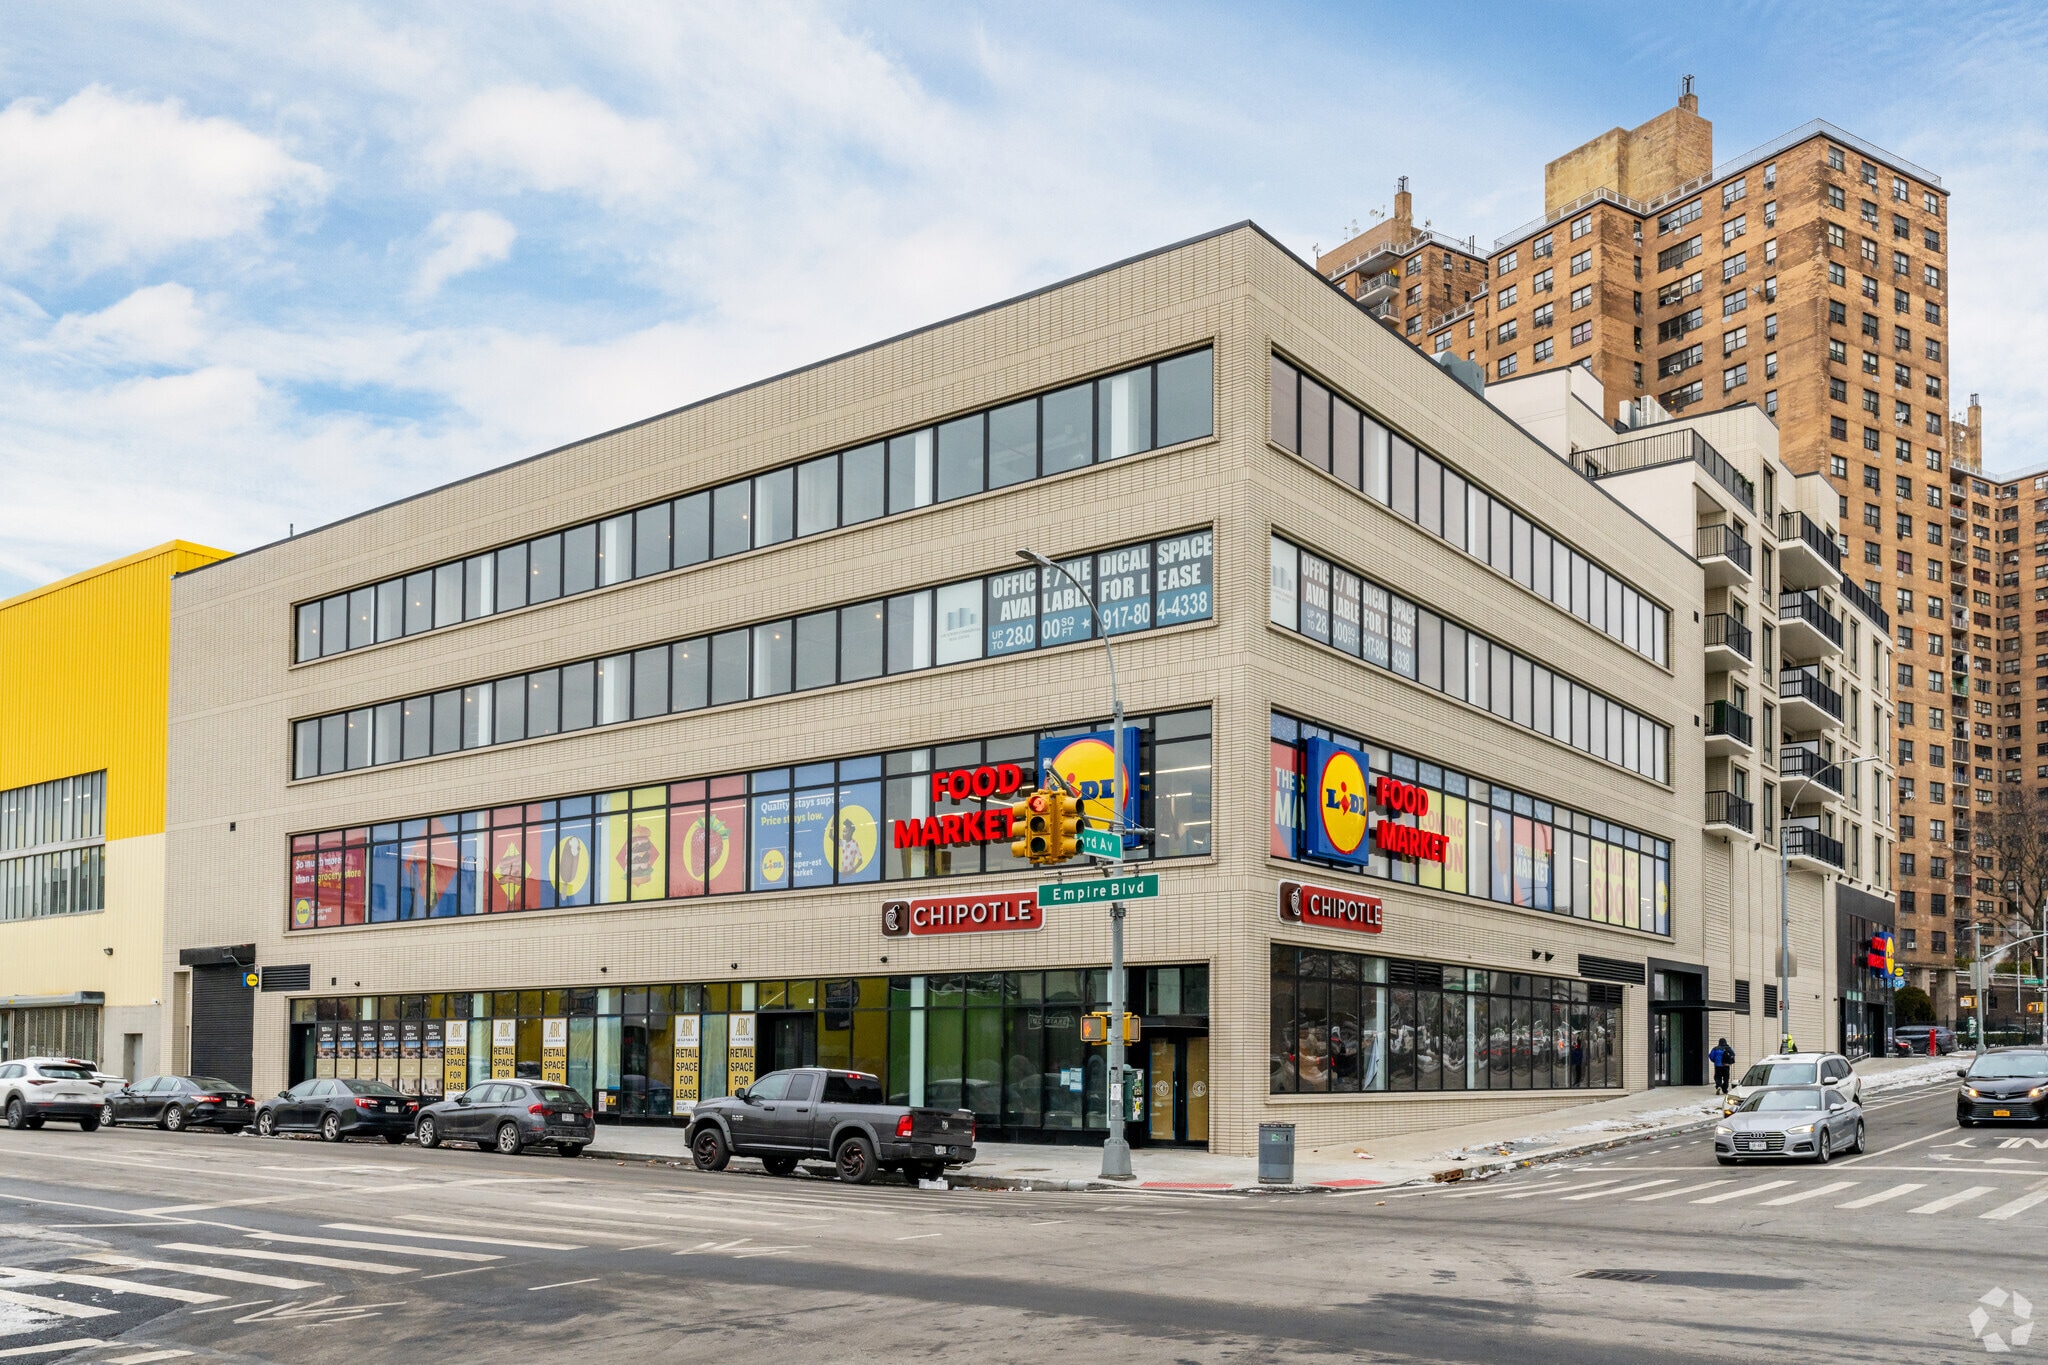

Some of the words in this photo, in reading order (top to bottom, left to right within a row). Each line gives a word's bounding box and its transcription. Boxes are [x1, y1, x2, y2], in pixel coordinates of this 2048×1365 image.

[993, 567, 1051, 599] OFFICE
[1066, 547, 1150, 584] MEDICAL
[1157, 533, 1212, 565] SPACE
[1000, 584, 1092, 622] AVAILABLE
[1101, 576, 1134, 602] FOR
[1141, 562, 1201, 595] LEASE
[1302, 554, 1338, 590] OFFICE
[1346, 576, 1389, 614] MEDICAL
[1391, 596, 1416, 627] SPACE
[1103, 590, 1208, 631] 917-804-4338
[1305, 581, 1360, 625] AVAILABLE
[1364, 608, 1382, 635] FOR
[1384, 617, 1412, 648] LEASE
[1307, 608, 1315, 619] UP
[1061, 616, 1075, 627] SQ
[1307, 619, 1315, 631] TO
[991, 629, 1004, 640] UP
[1005, 618, 1060, 647] 28,000
[1061, 626, 1074, 637] FT
[992, 640, 1004, 650] TO
[931, 763, 1024, 803] FOOD
[1275, 766, 1296, 791] THE
[1376, 776, 1429, 817] FOOD
[761, 800, 790, 814] Quality
[794, 797, 815, 809] stays
[816, 795, 844, 808] supe.
[761, 815, 782, 826] Price
[807, 811, 824, 823] low.
[894, 807, 1016, 849] MARKET
[1100, 836, 1113, 852] Av
[1376, 819, 1449, 863] MARKET
[295, 859, 304, 869] So
[304, 856, 324, 867] muh
[325, 856, 342, 865] more
[788, 858, 822, 870] uper-est
[295, 874, 310, 884] than
[310, 874, 315, 882] a
[317, 871, 342, 885] grocery
[344, 869, 362, 879] store
[1052, 885, 1107, 902] Empire
[1111, 881, 1145, 896] Blvd
[913, 900, 1032, 927] CHIPOTLE
[1310, 894, 1382, 925] CHIPOTLE
[446, 1047, 466, 1055] RETAIL
[493, 1047, 514, 1055] RETAIL
[543, 1048, 566, 1057] RETAIL
[675, 1048, 699, 1058] RETAIL
[730, 1048, 754, 1058] RETAIL
[446, 1058, 466, 1067] SPACE
[493, 1058, 514, 1067] SPACE
[544, 1060, 565, 1070] SPACE
[676, 1062, 698, 1072] SPACE
[730, 1062, 754, 1072] SPACE
[449, 1071, 462, 1079] FOR
[497, 1069, 510, 1078] FOR
[547, 1072, 561, 1082] FOR
[679, 1075, 694, 1085] FOR
[734, 1075, 749, 1086] FOR
[446, 1082, 465, 1091] LEASE
[676, 1088, 697, 1099] LEASE
